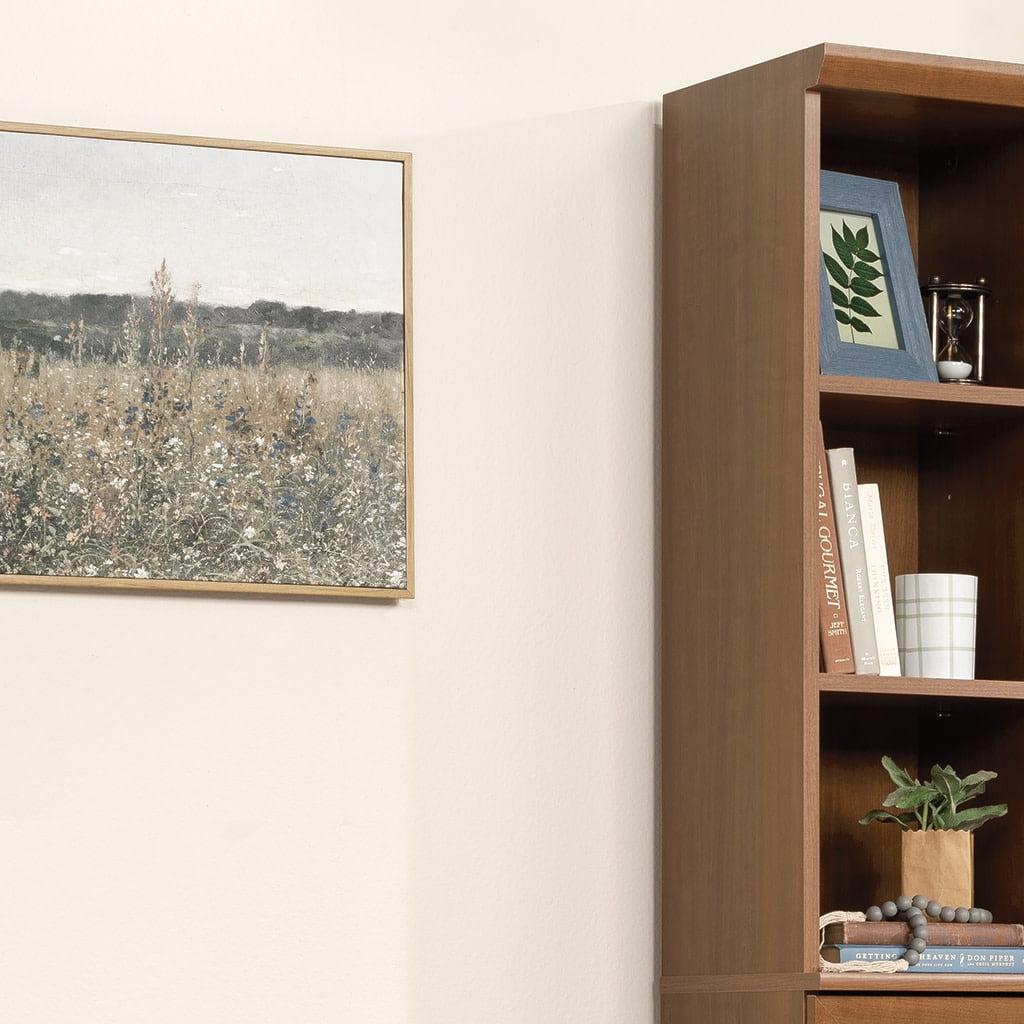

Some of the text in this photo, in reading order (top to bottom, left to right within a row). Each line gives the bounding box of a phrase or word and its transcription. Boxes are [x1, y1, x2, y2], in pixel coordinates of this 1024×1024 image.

[842, 482, 858, 550] BIANCA
[818, 526, 841, 610] GOURMET
[919, 953, 957, 961] HEAVEN
[967, 954, 1015, 962] DON PIPER
